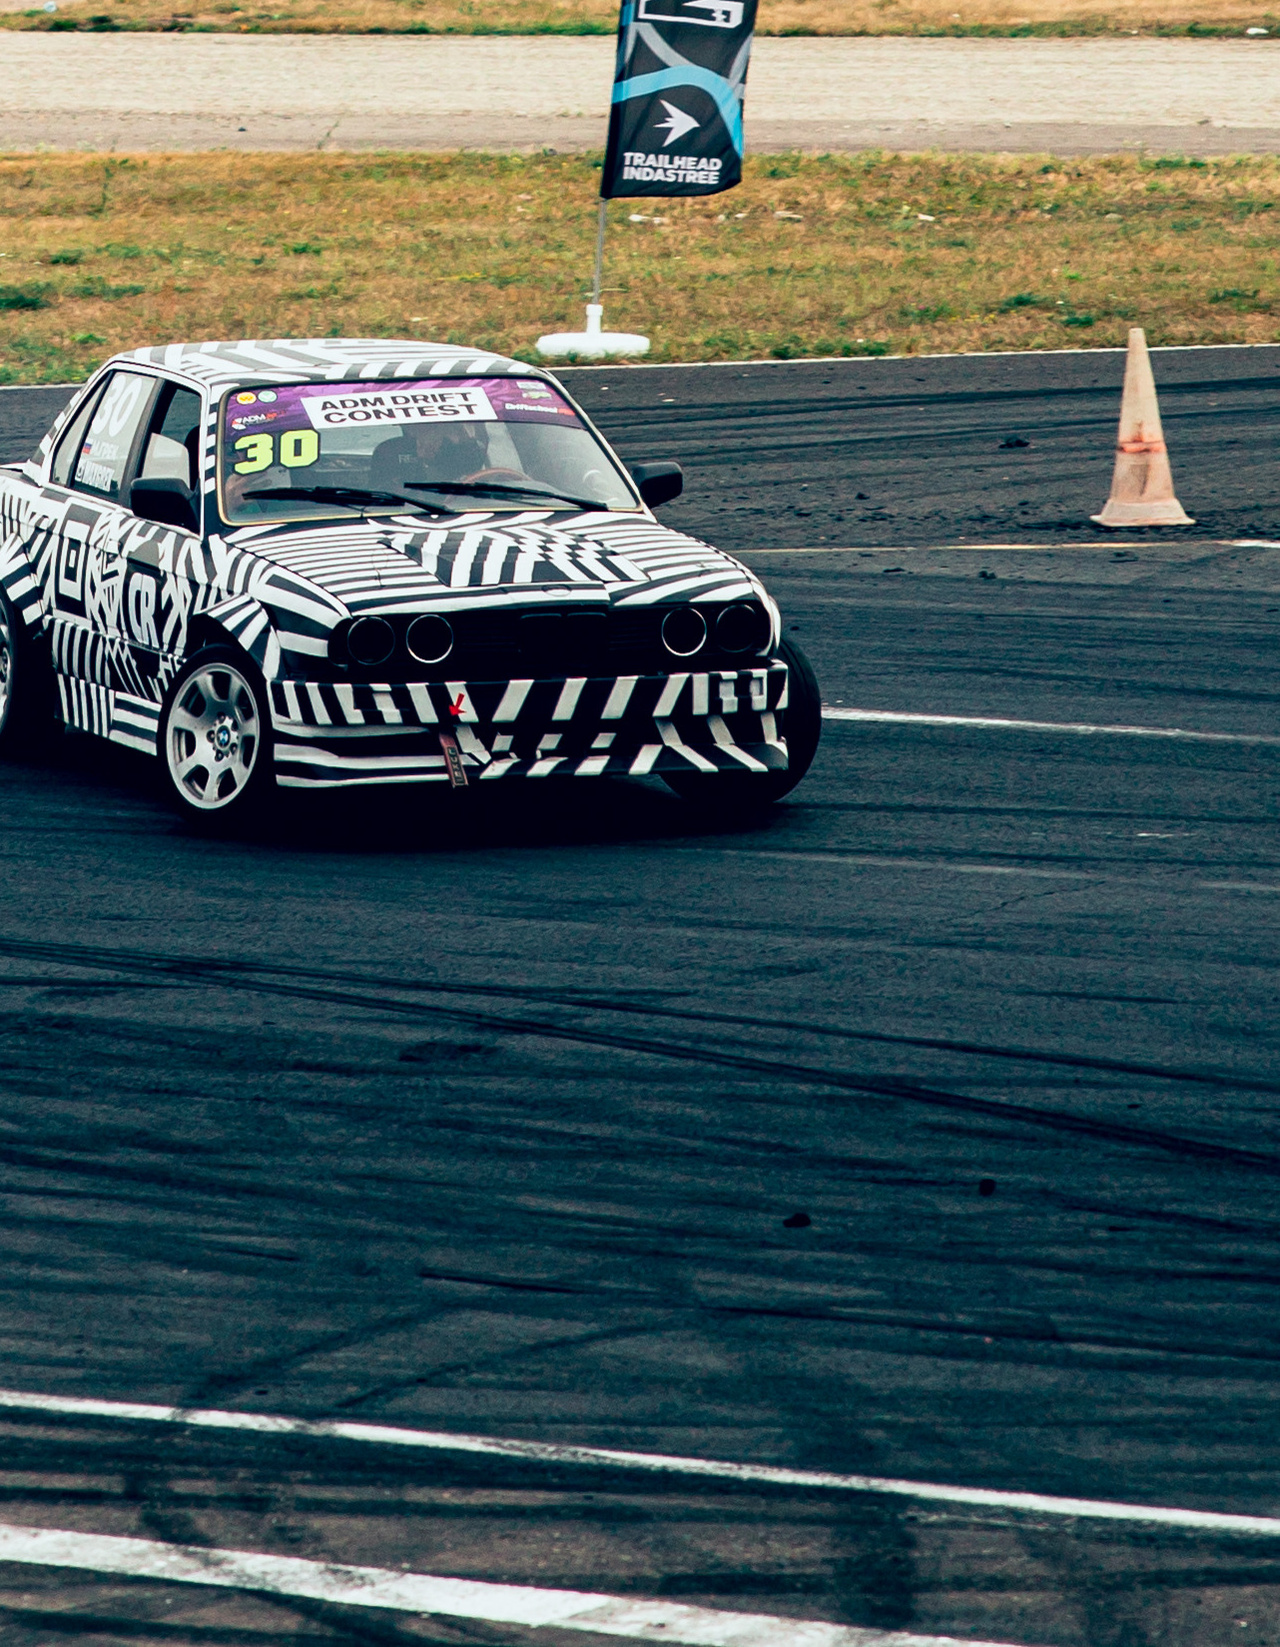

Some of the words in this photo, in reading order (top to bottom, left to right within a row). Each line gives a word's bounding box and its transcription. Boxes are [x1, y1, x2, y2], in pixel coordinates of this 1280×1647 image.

[623, 152, 723, 171] TRAILHEAD
[623, 166, 720, 184] INDASTREE
[92, 374, 143, 437] 30
[321, 396, 386, 411] ADM
[390, 392, 472, 406] DRIFT
[324, 404, 478, 424] CONTEST
[234, 429, 319, 474] 30
